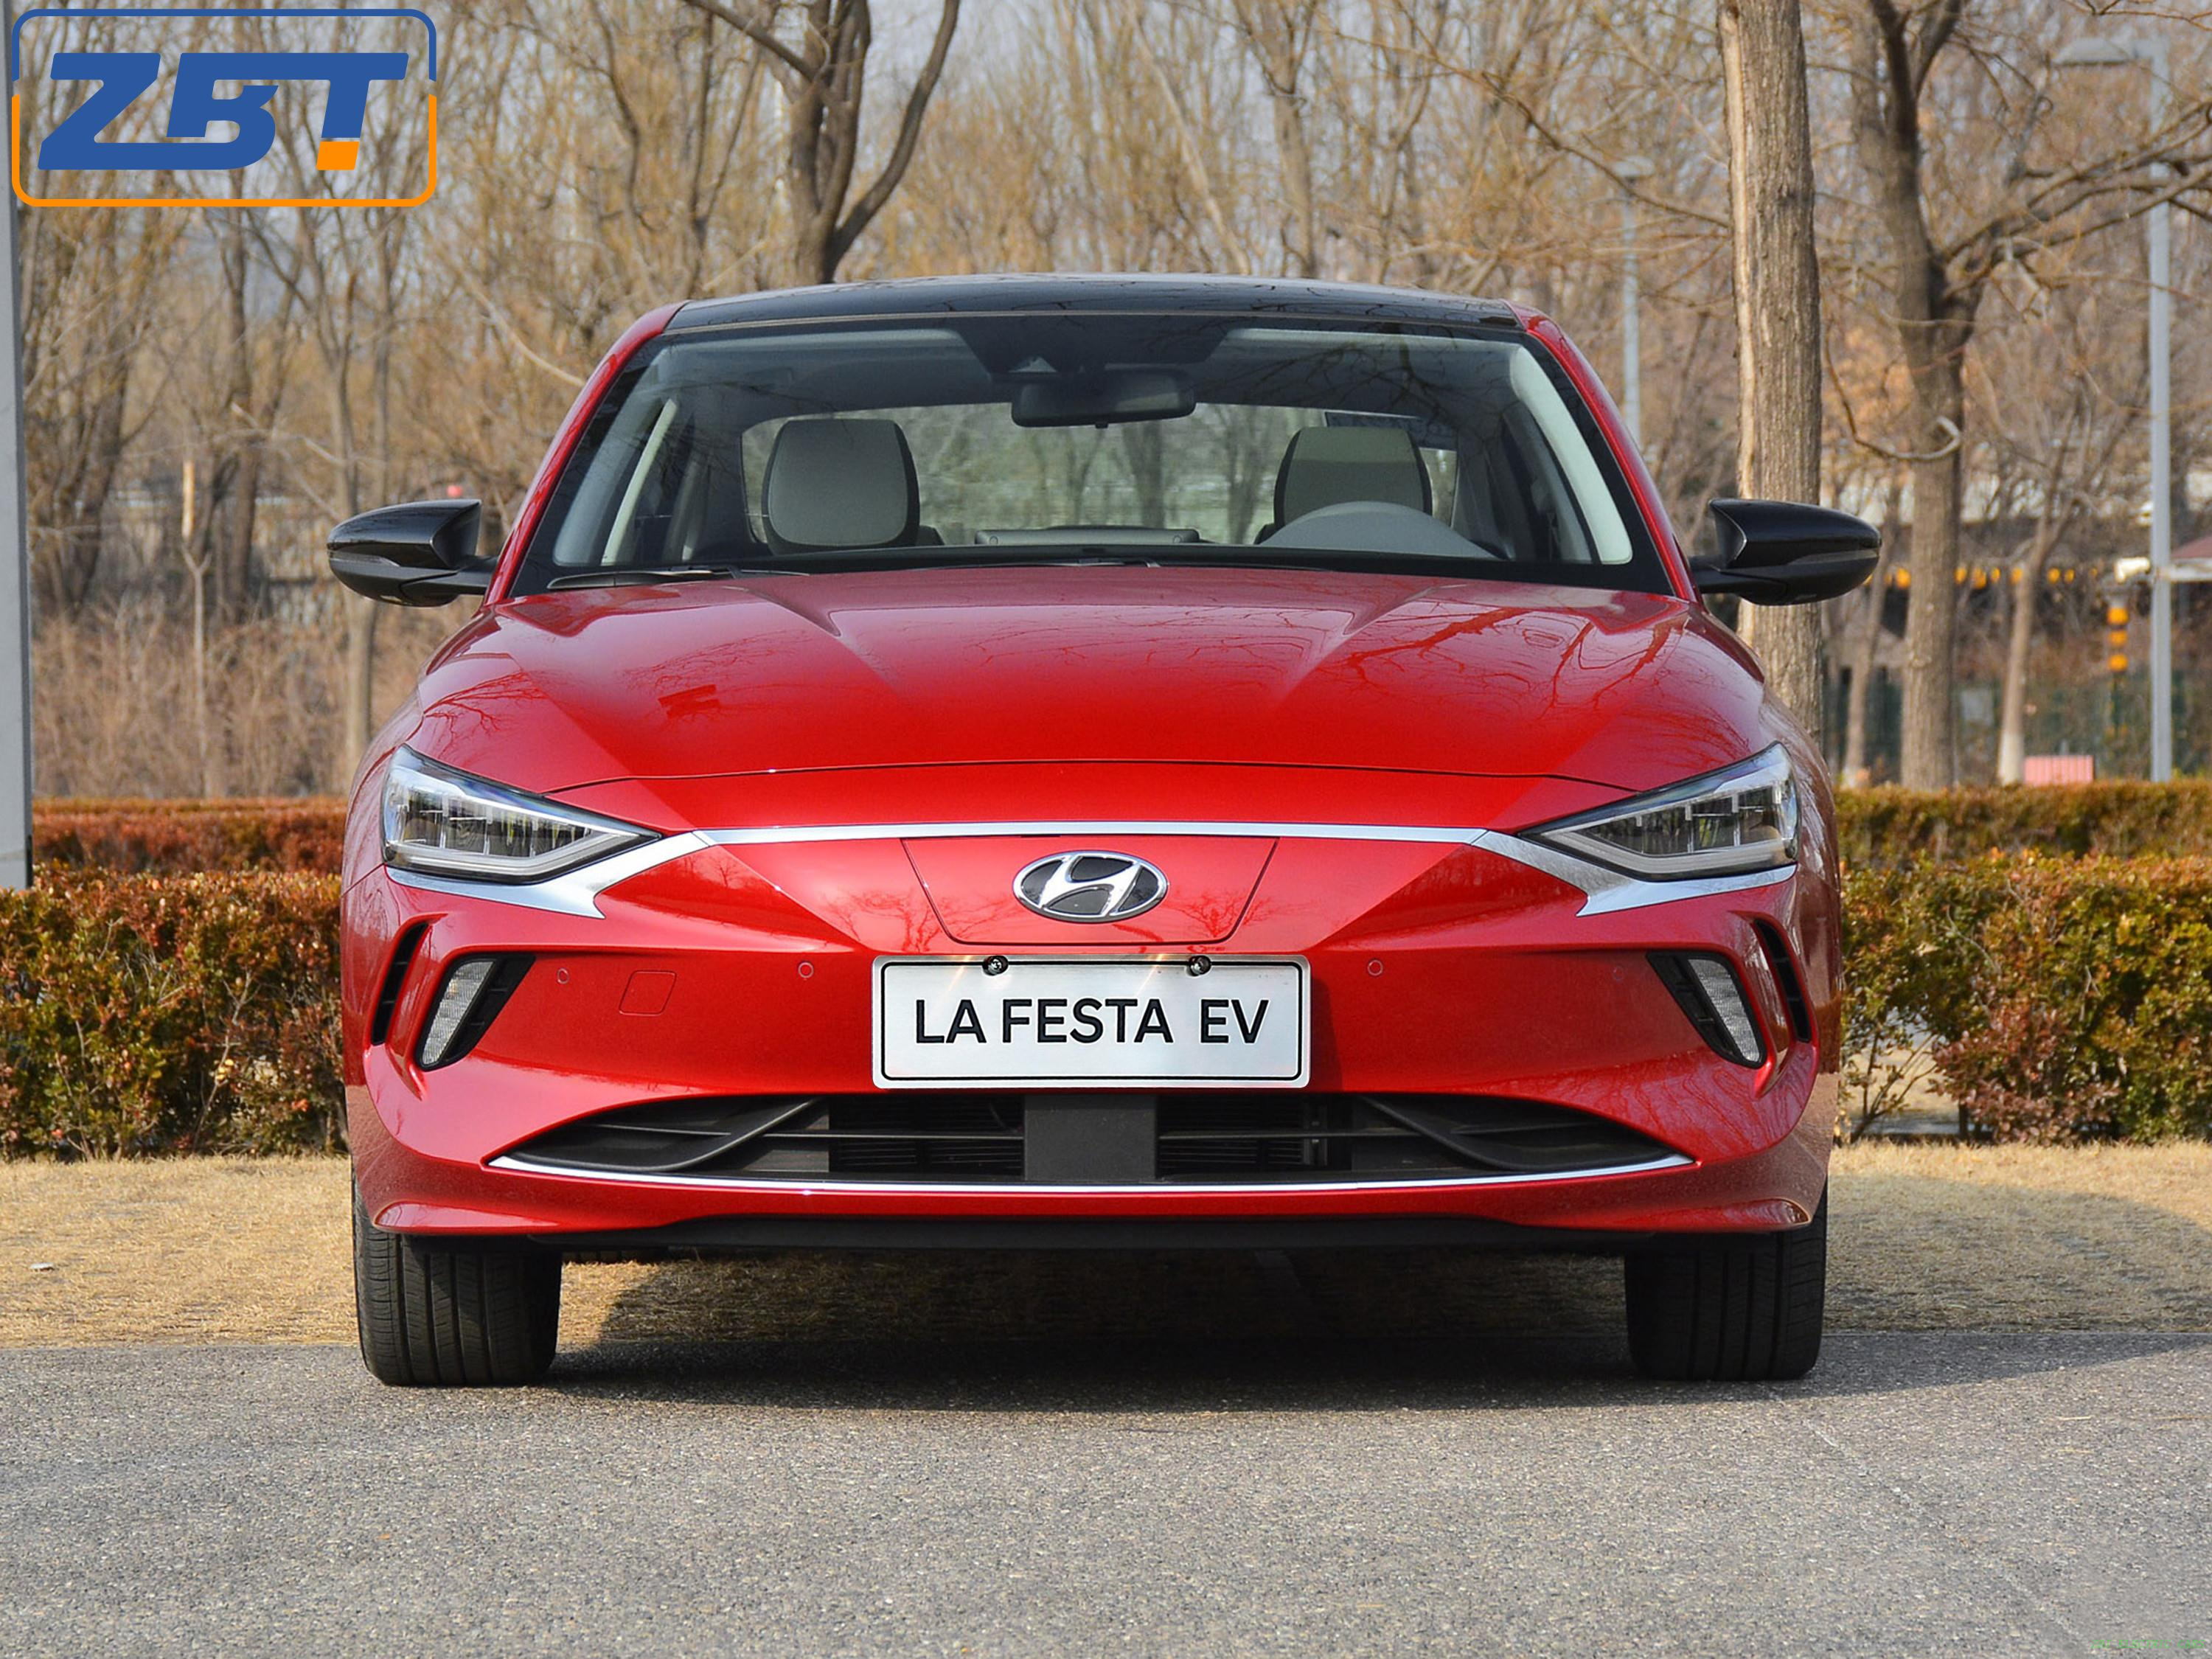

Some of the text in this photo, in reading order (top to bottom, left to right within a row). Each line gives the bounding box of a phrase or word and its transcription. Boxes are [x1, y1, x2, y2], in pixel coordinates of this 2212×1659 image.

[915, 998, 1269, 1044] LA FESTA EV
